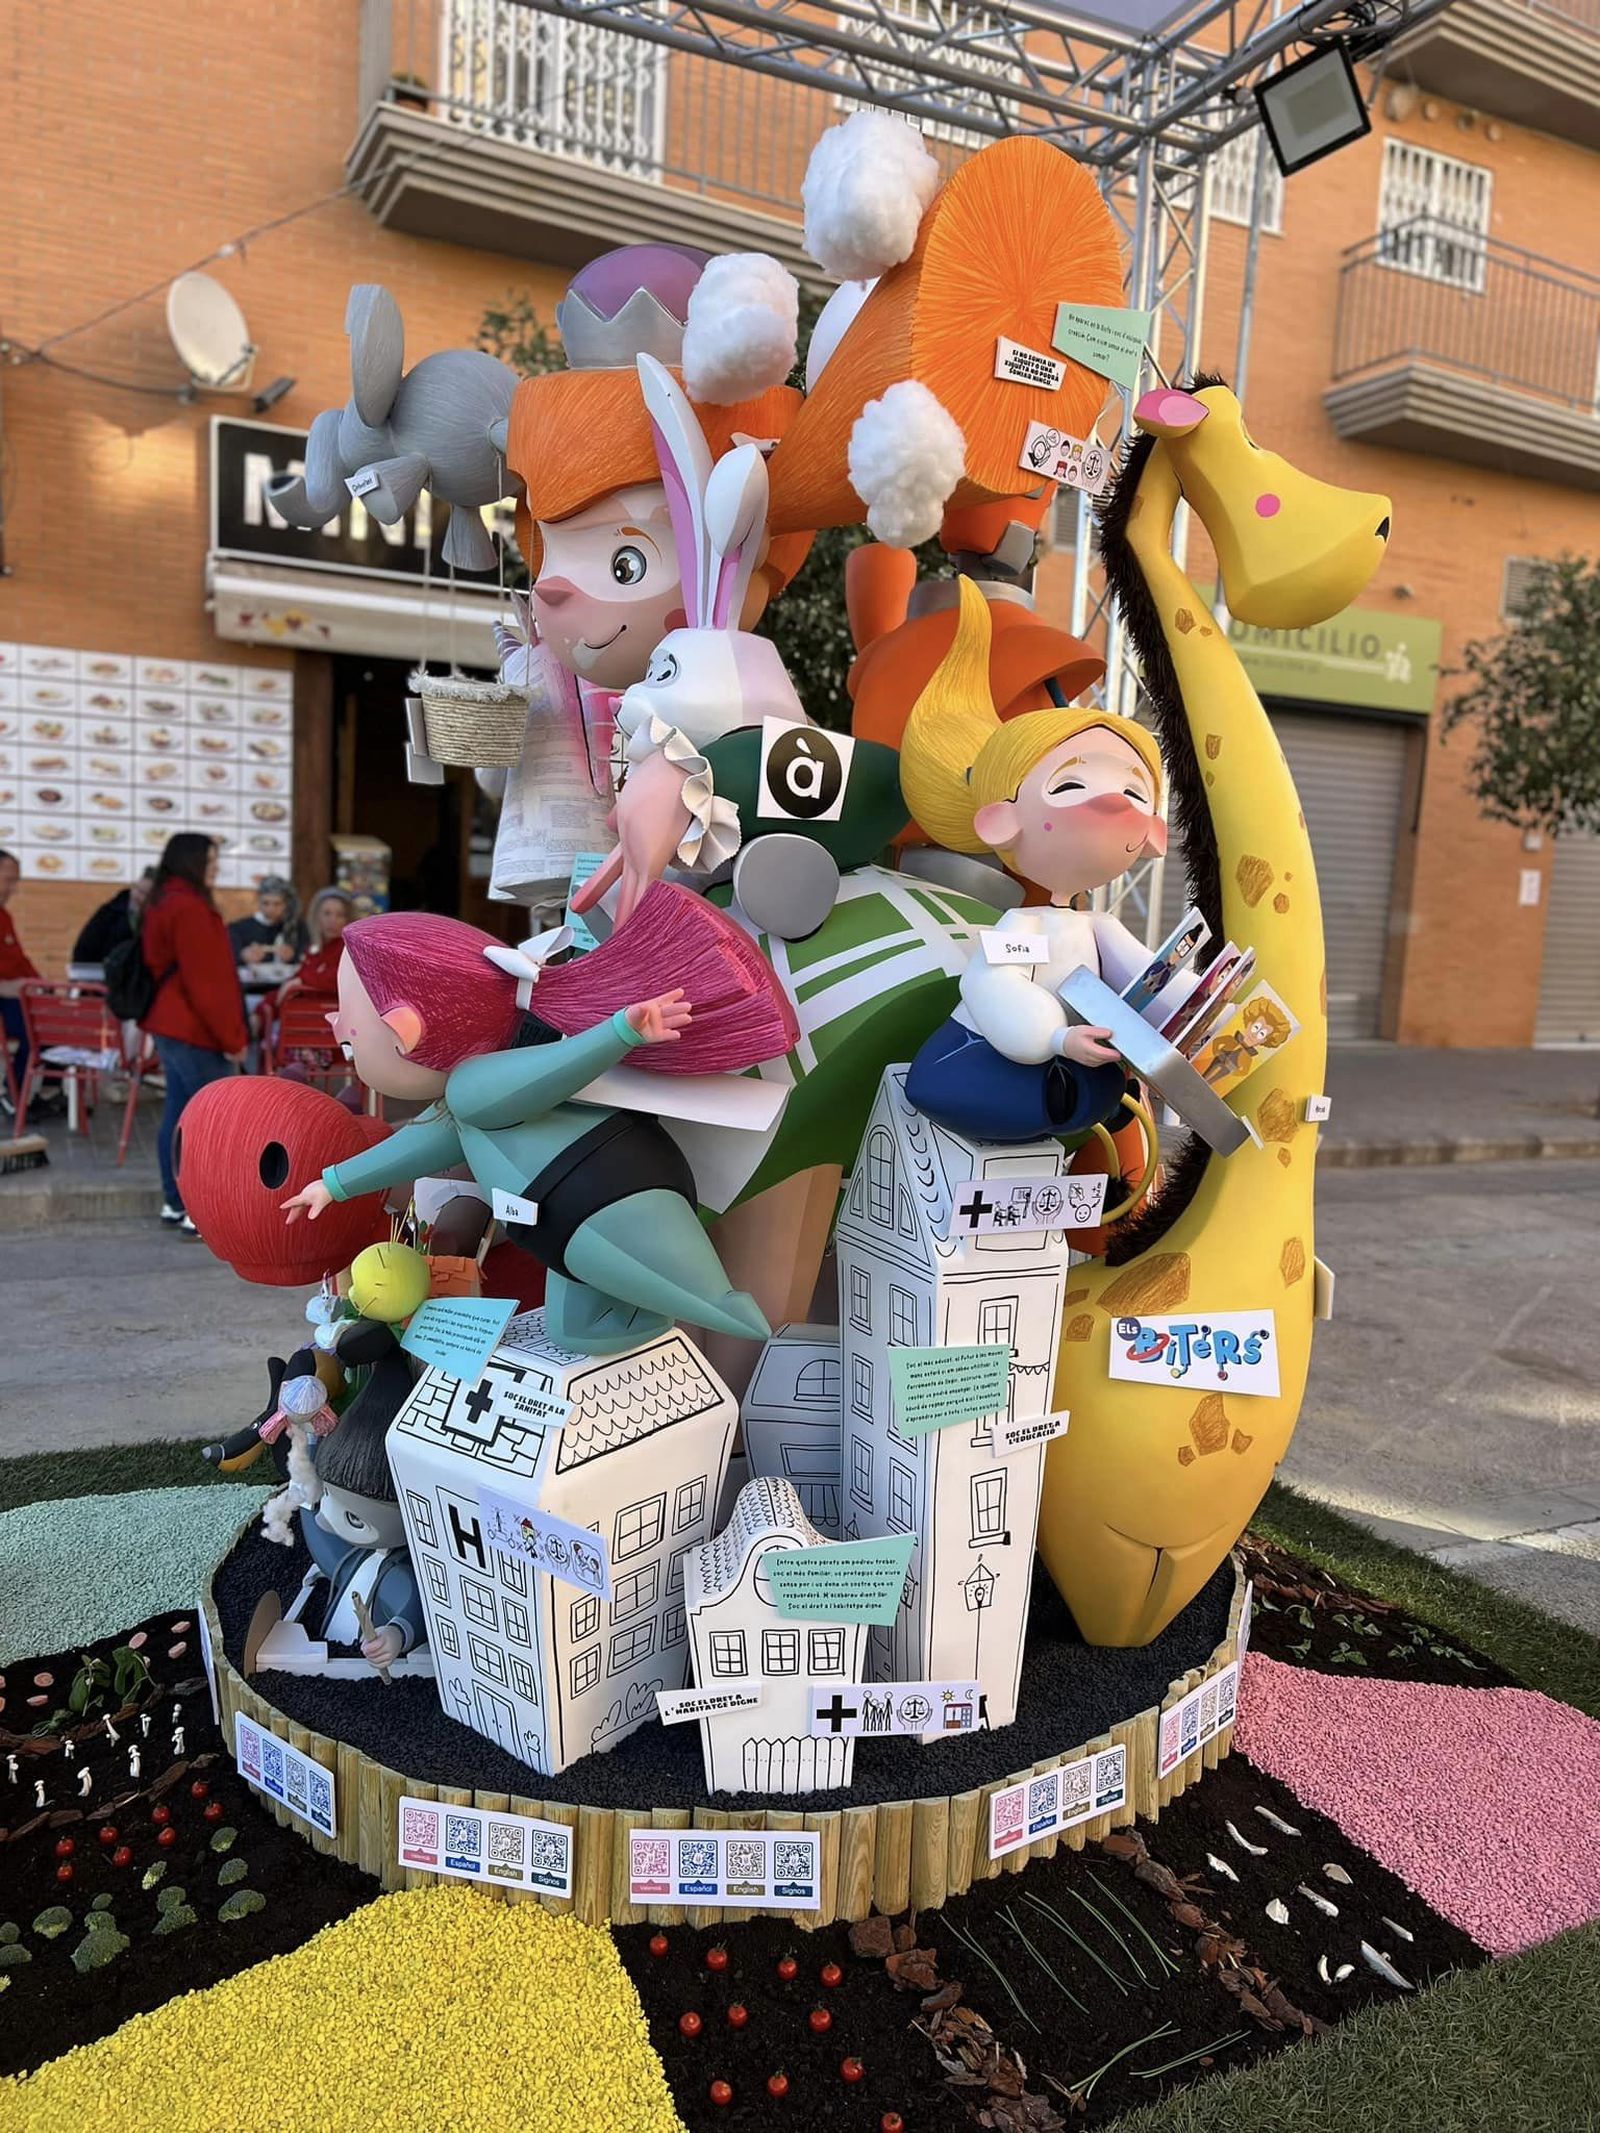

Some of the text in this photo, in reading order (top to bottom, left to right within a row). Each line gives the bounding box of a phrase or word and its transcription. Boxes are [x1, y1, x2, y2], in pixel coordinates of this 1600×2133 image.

[1028, 354, 1046, 365] SOMIA
[1047, 360, 1056, 368] UN
[1030, 368, 1038, 376] NO
[1040, 365, 1052, 374] UNA
[786, 737, 825, 799] à
[1118, 1323, 1138, 1335] Els
[504, 1390, 518, 1400] SOC
[518, 1394, 527, 1404] EL
[528, 1398, 549, 1410] DRET
[554, 1406, 566, 1416] LA
[514, 1402, 548, 1418] SANITAT
[1006, 1429, 1021, 1440] SOC
[1032, 1422, 1052, 1432] DRET
[1054, 1420, 1061, 1428] A
[448, 1503, 487, 1569] H
[679, 1700, 696, 1708] SOC
[698, 1698, 708, 1706] EL
[710, 1695, 734, 1704] DRET
[730, 1697, 758, 1707] DIGNE
[450, 1858, 476, 1870] Español
[494, 1868, 518, 1879] English
[538, 1875, 560, 1887] Signos
[684, 1884, 712, 1894] Español
[732, 1886, 759, 1896] English
[781, 1886, 806, 1896] Signos
